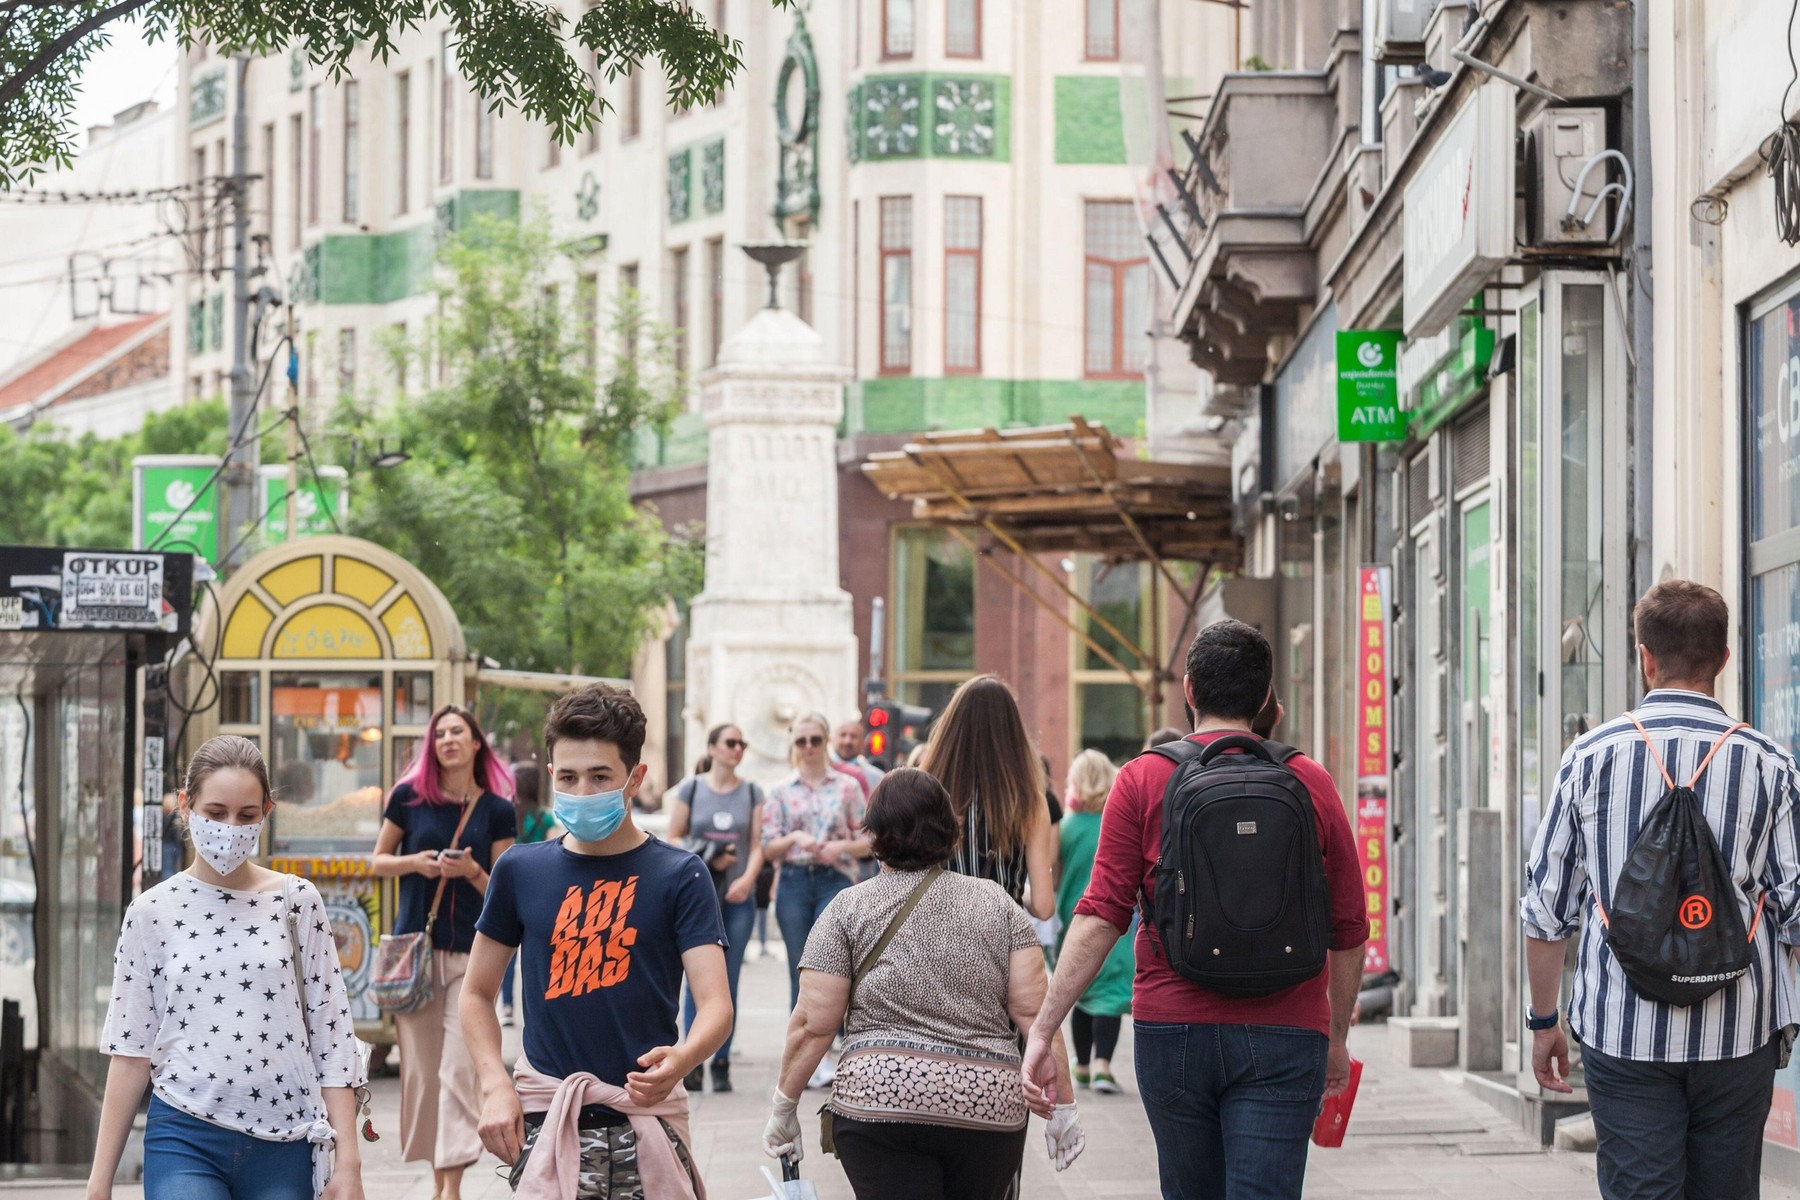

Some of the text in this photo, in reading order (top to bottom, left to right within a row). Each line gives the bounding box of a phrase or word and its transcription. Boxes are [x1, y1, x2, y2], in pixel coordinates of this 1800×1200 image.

[1351, 406, 1396, 424] ATM
[69, 558, 158, 575] OTKUP
[1365, 626, 1382, 755] ROOMS
[550, 875, 639, 945] ADI
[1366, 838, 1382, 941] SOBE
[544, 926, 638, 1000] DAS
